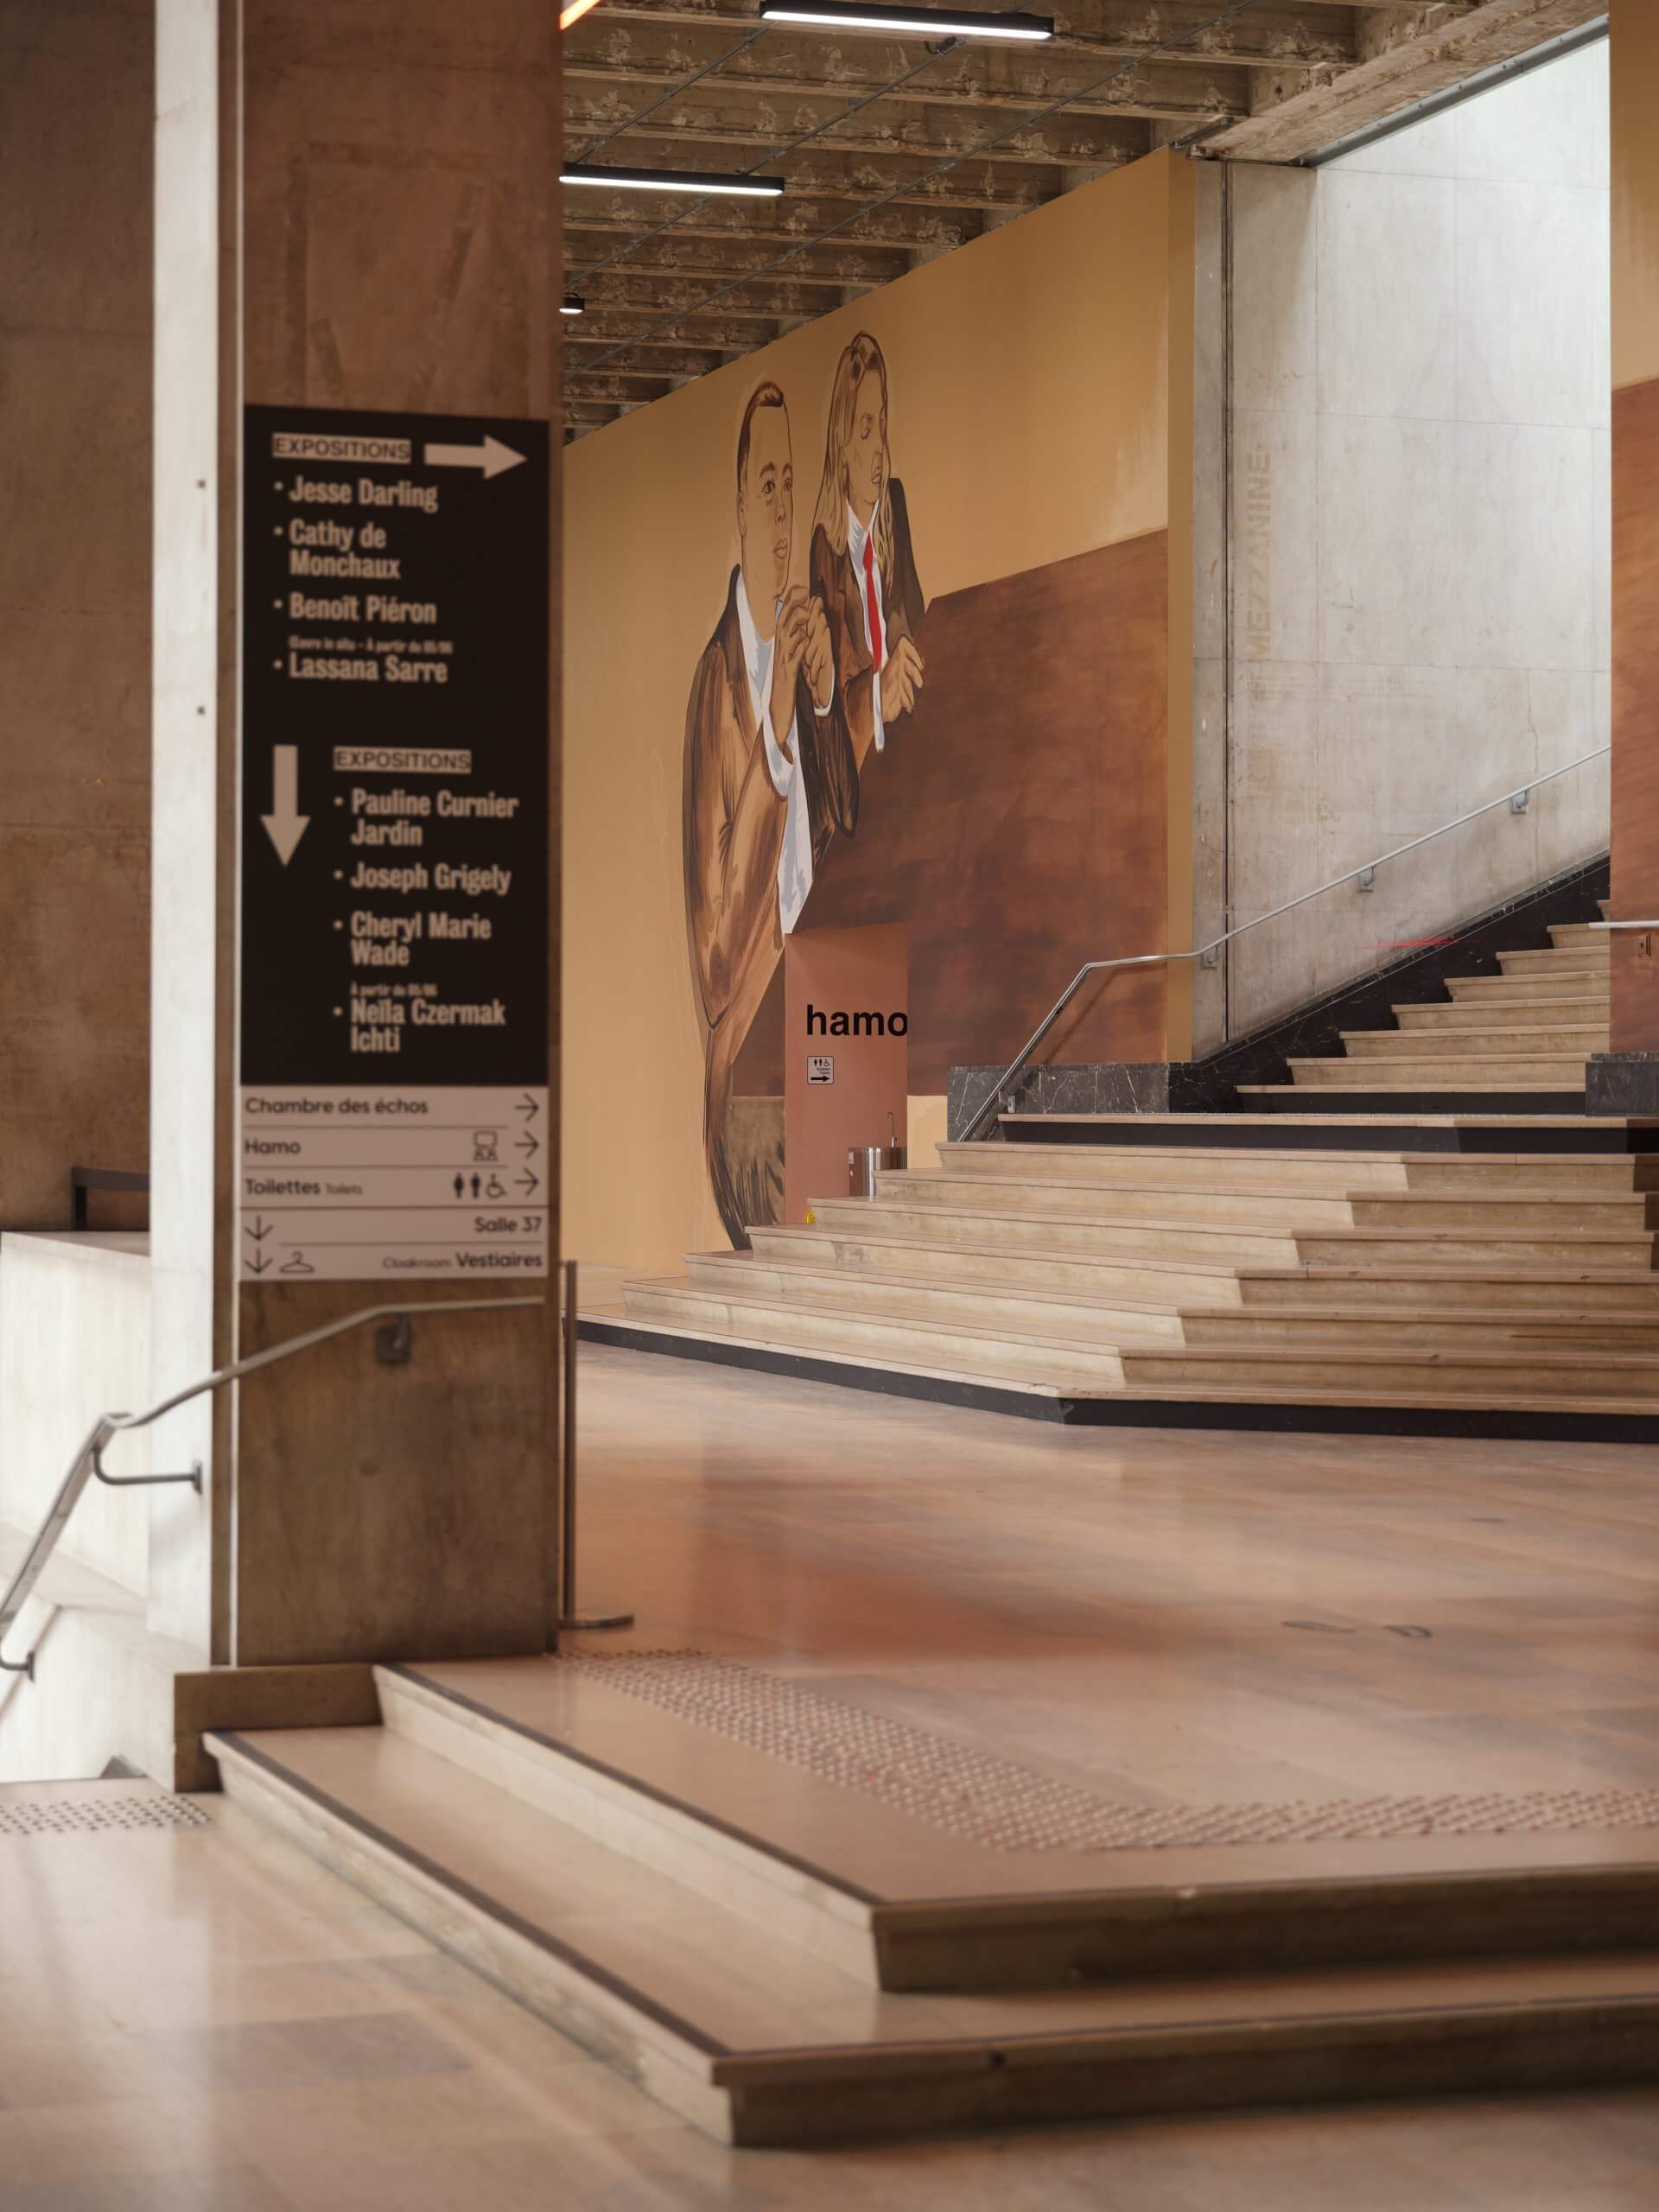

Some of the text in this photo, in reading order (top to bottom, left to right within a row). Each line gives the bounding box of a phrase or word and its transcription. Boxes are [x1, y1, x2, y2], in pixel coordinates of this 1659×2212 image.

[275, 436, 410, 460] EXPOSITIONS
[289, 475, 438, 512] Jesse Darling
[289, 518, 387, 551] Cathy de
[289, 549, 401, 579] Monchaux
[289, 593, 436, 623] Benoît Piéron
[289, 652, 448, 683] Lassana Sarre
[336, 750, 471, 771] EXPOSITIONS
[352, 788, 518, 817] Pauline Curnier
[351, 819, 423, 845] Jardin
[351, 862, 512, 895] Joseph Grigely
[351, 912, 492, 943] Cheryl Marie
[351, 939, 410, 965] Wade
[411, 997, 505, 1025] Czermak
[806, 1004, 907, 1037] hamo
[351, 1027, 400, 1052] Ichti
[245, 1096, 429, 1114] Chambre des échos
[245, 1139, 301, 1154] Hamo
[245, 1179, 321, 1195] Toilettes
[474, 1217, 542, 1233] Salle 37
[455, 1252, 543, 1268] Vestiaires
